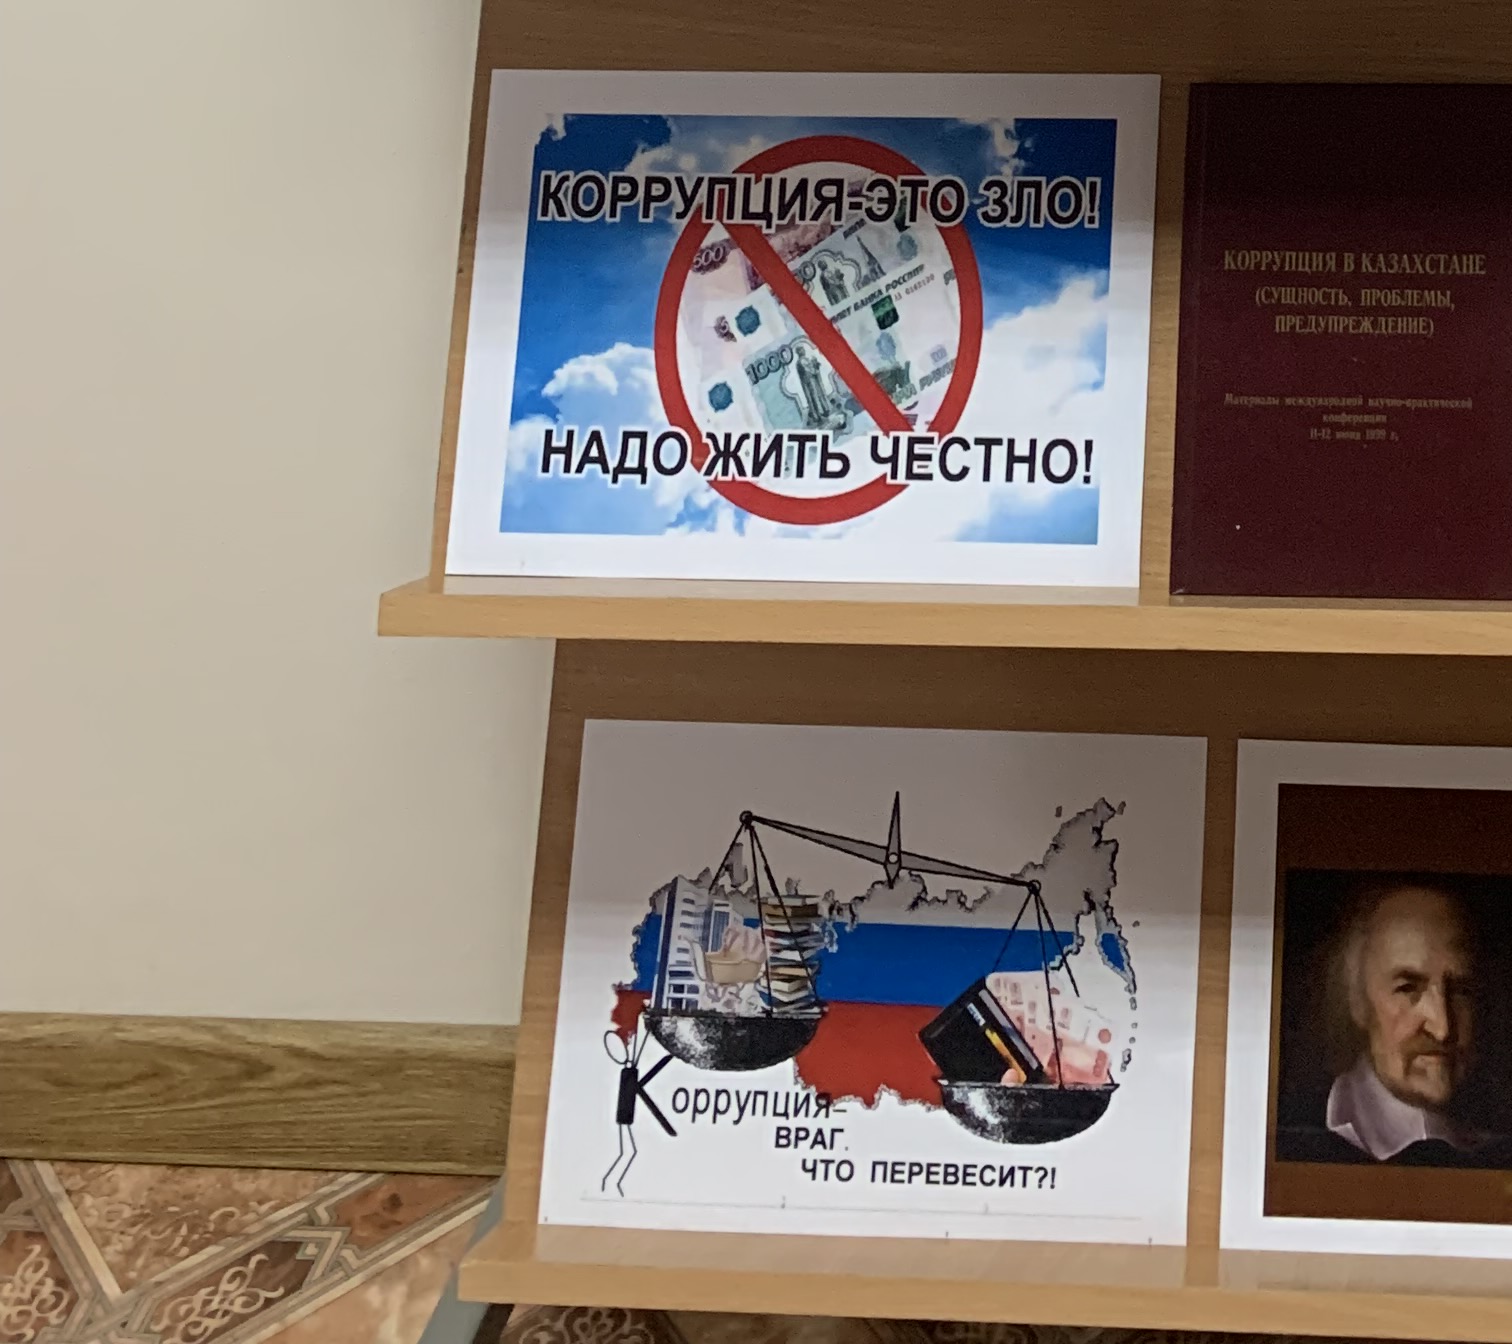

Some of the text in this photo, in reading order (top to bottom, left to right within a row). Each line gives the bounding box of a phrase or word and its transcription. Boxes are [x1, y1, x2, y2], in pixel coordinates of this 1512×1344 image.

[540, 173, 1100, 233] КОРРУПЦИЯ-ЭТО ЗЛО!
[1223, 250, 1486, 275] КОРРУПЦИЯ КАЗАХСТАНЕ
[1255, 286, 1455, 310] (СУЩНОСТЬ, ПРОБЛЕМЫ,
[1275, 315, 1434, 336] ПРЕДУПРЕЖДЕНИЕ)
[541, 429, 1094, 485] НАДО ЖИТЬ ЧЕСТНО!
[775, 1127, 848, 1151] ВРАГ.
[802, 1158, 1057, 1190] ЧТО ПЕРЕВЕСИТ?!
